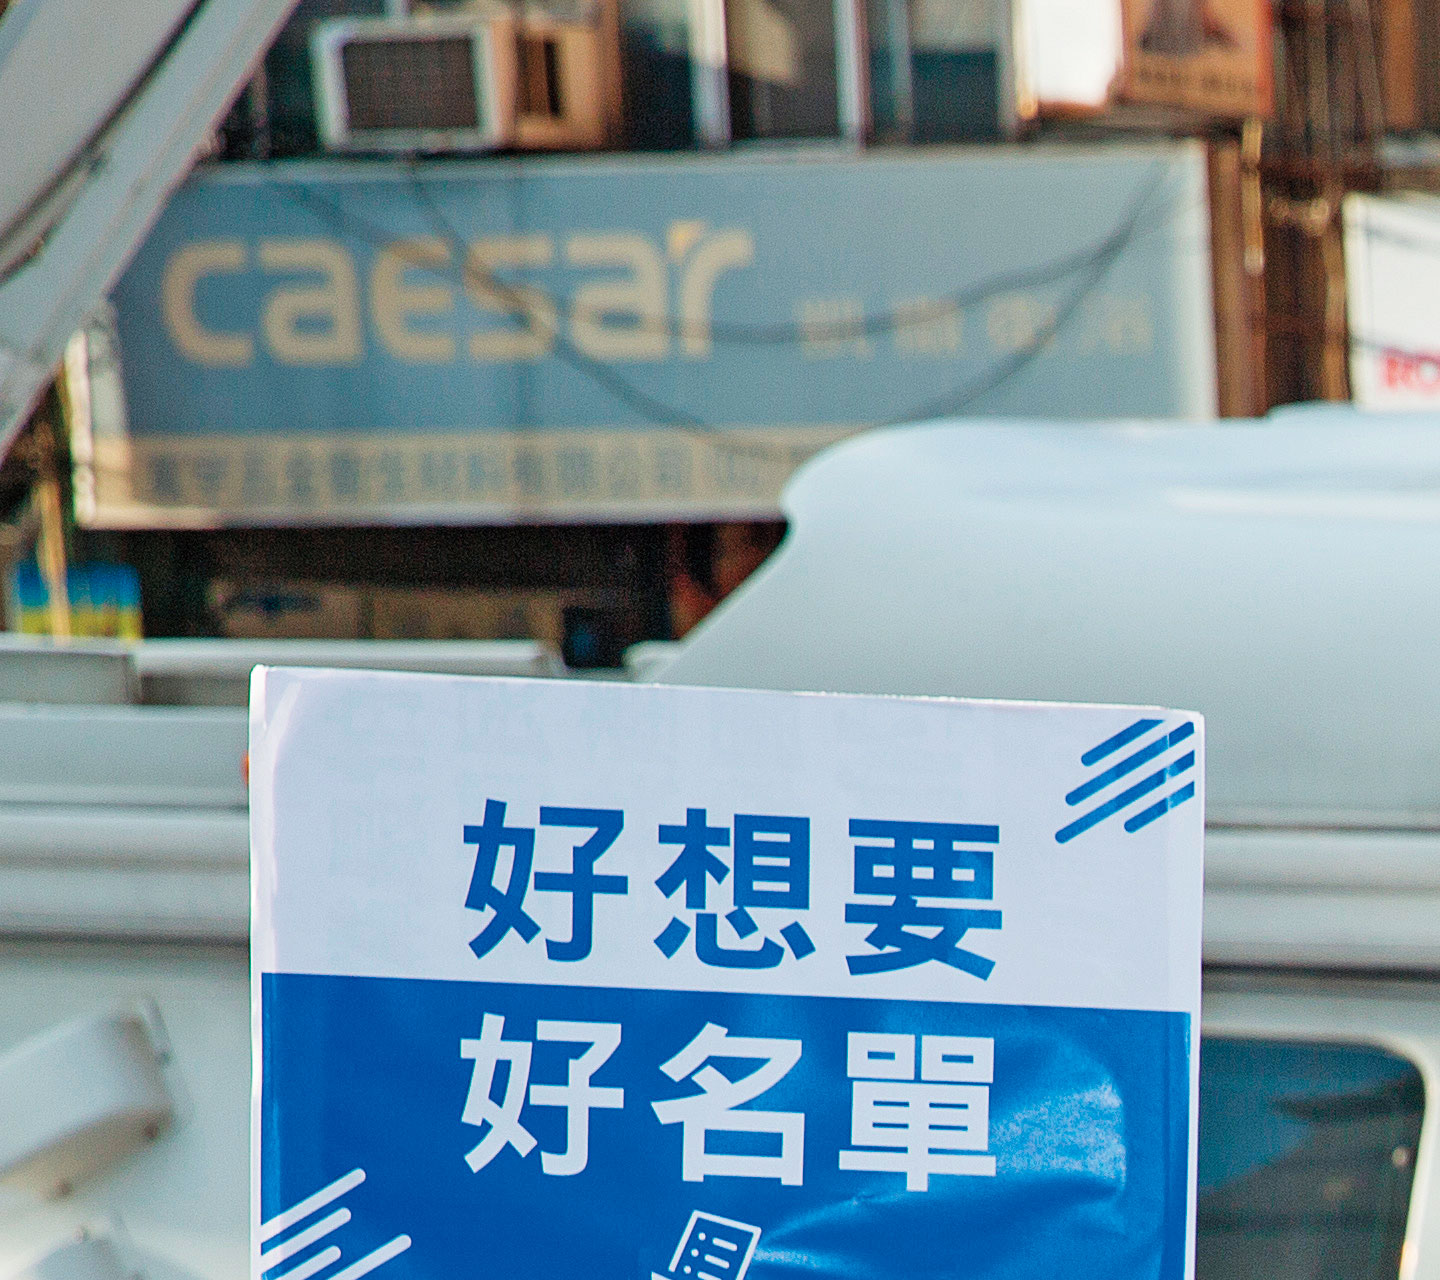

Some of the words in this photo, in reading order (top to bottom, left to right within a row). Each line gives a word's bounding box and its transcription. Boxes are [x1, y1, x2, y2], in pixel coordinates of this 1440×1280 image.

[162, 222, 756, 367] caesar
[463, 797, 1002, 982] 好想要
[460, 1012, 997, 1192] 好名單
